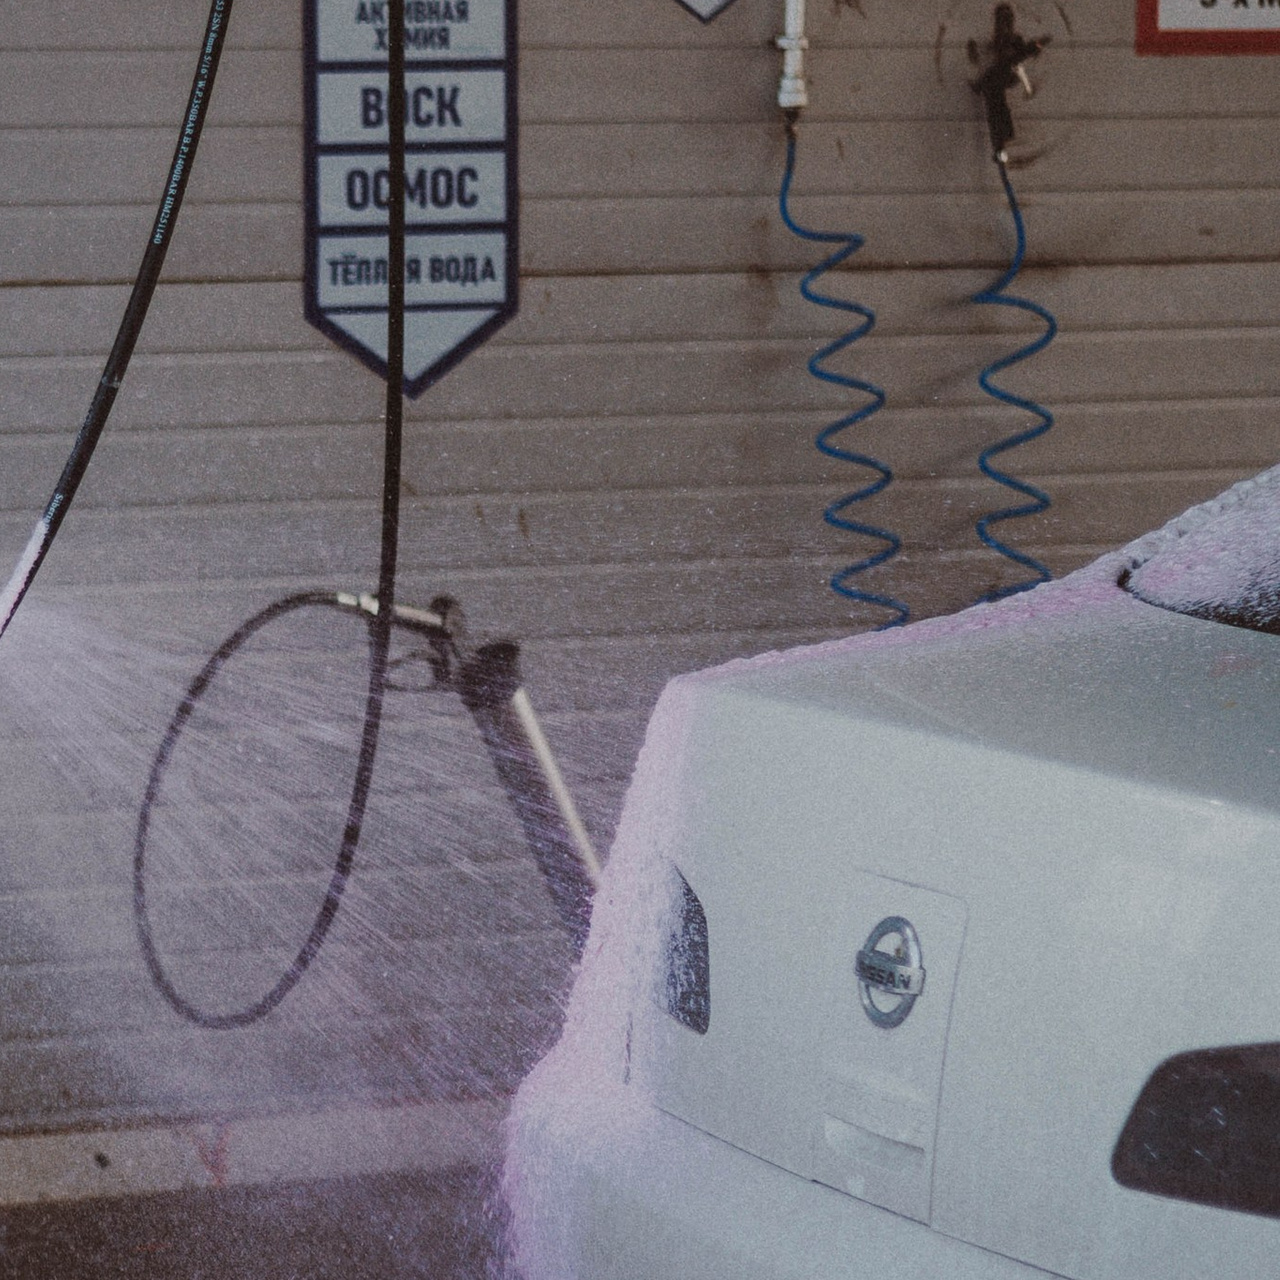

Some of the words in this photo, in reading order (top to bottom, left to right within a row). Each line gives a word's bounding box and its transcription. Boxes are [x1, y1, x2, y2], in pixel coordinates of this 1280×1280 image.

[356, 1, 469, 24] АКИВНАЯ
[374, 27, 450, 50] ХМИЯ
[362, 86, 461, 128] ВСК
[328, 253, 421, 285] ТЁПЛЯ
[430, 257, 495, 286] ВОДА
